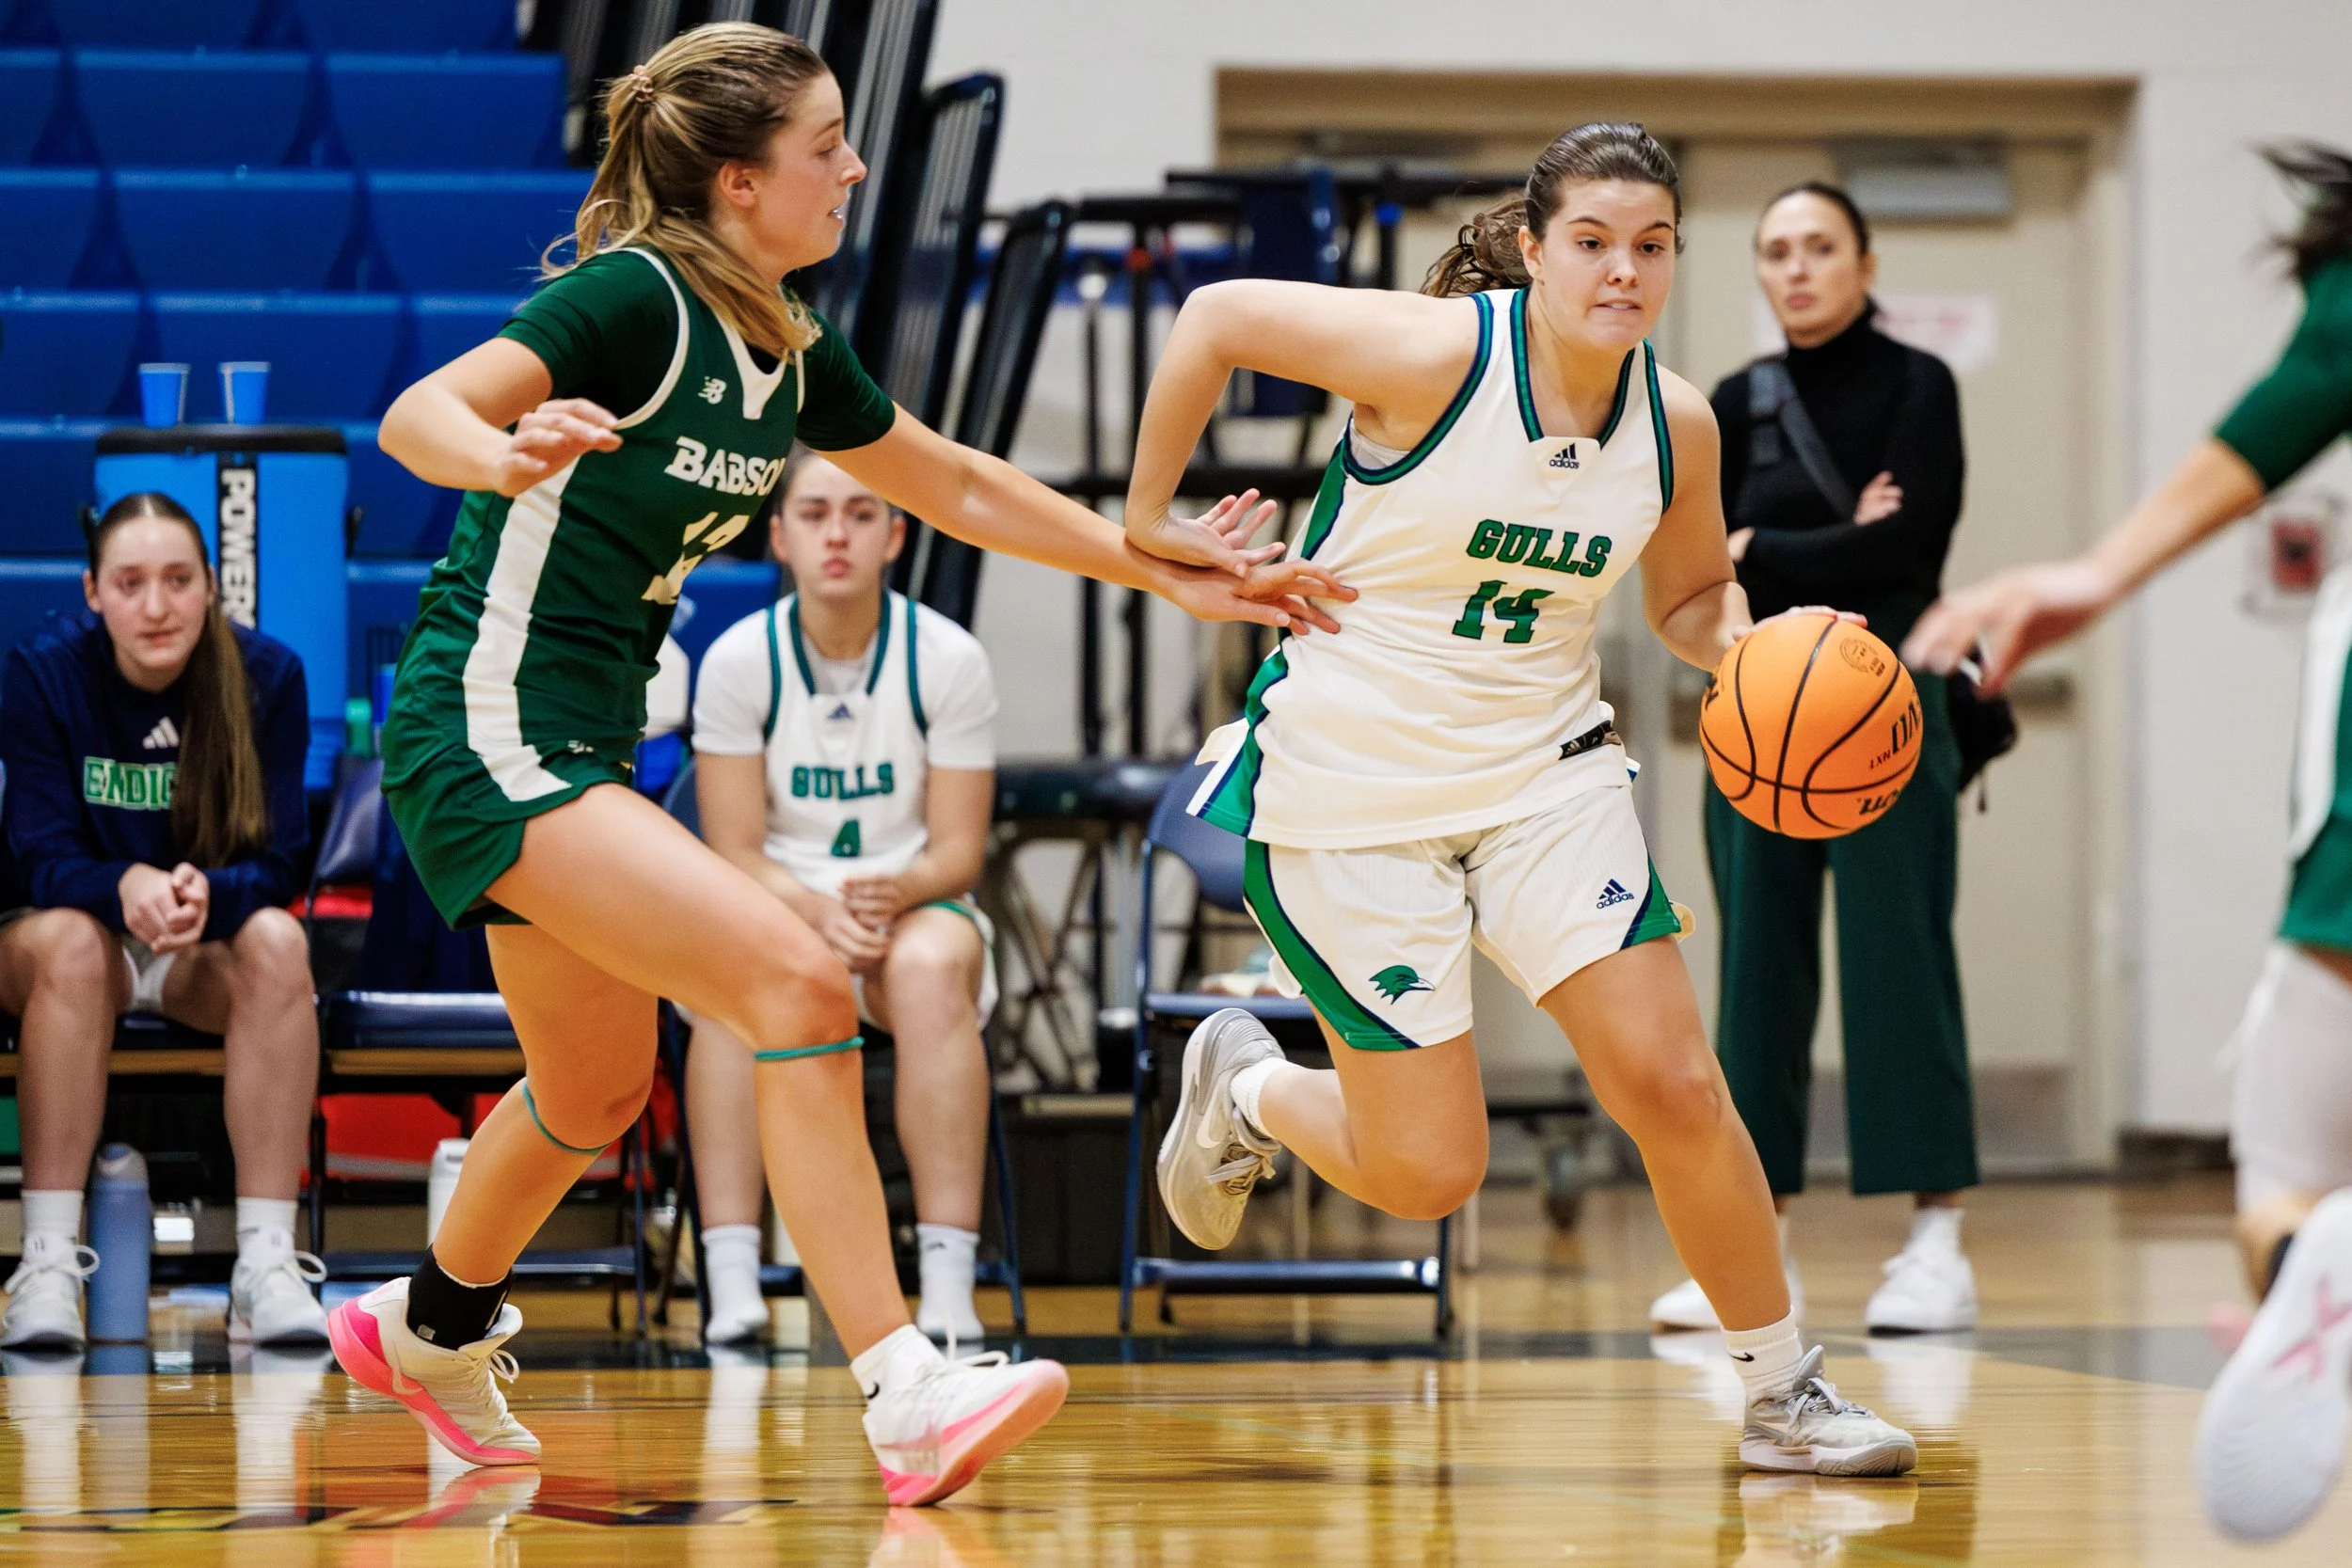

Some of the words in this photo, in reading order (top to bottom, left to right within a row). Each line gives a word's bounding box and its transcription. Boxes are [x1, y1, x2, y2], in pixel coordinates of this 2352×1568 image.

[664, 436, 786, 496] BABSO
[1549, 457, 1580, 469] adidas
[221, 468, 256, 628] POWER
[1466, 519, 1613, 578] GULLS
[1452, 579, 1555, 643] 14
[792, 760, 894, 800] GULLS
[831, 818, 861, 858] 4
[1596, 893, 1634, 910] adidas
